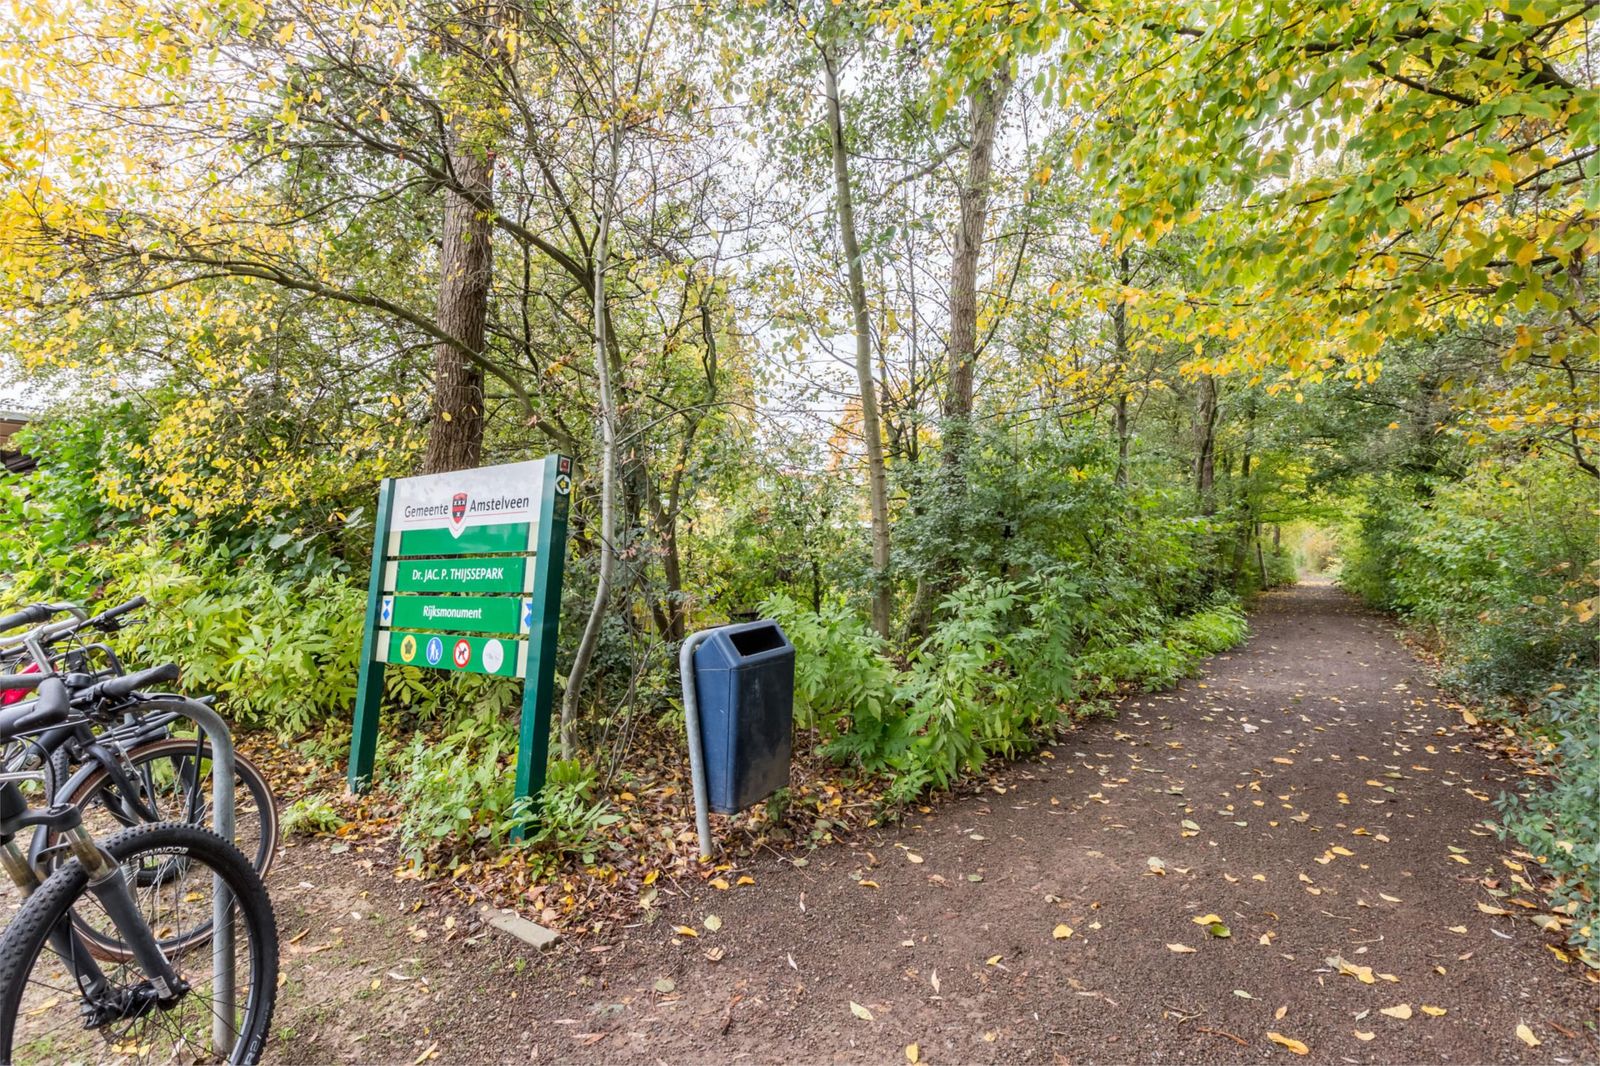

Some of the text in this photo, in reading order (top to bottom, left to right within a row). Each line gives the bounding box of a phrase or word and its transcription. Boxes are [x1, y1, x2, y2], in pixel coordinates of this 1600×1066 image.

[404, 496, 529, 518] Gemeente Amstelveen
[412, 567, 504, 583] Dr. JAC. P. THIJSSEPARK
[423, 604, 482, 620] Rijksmonument
